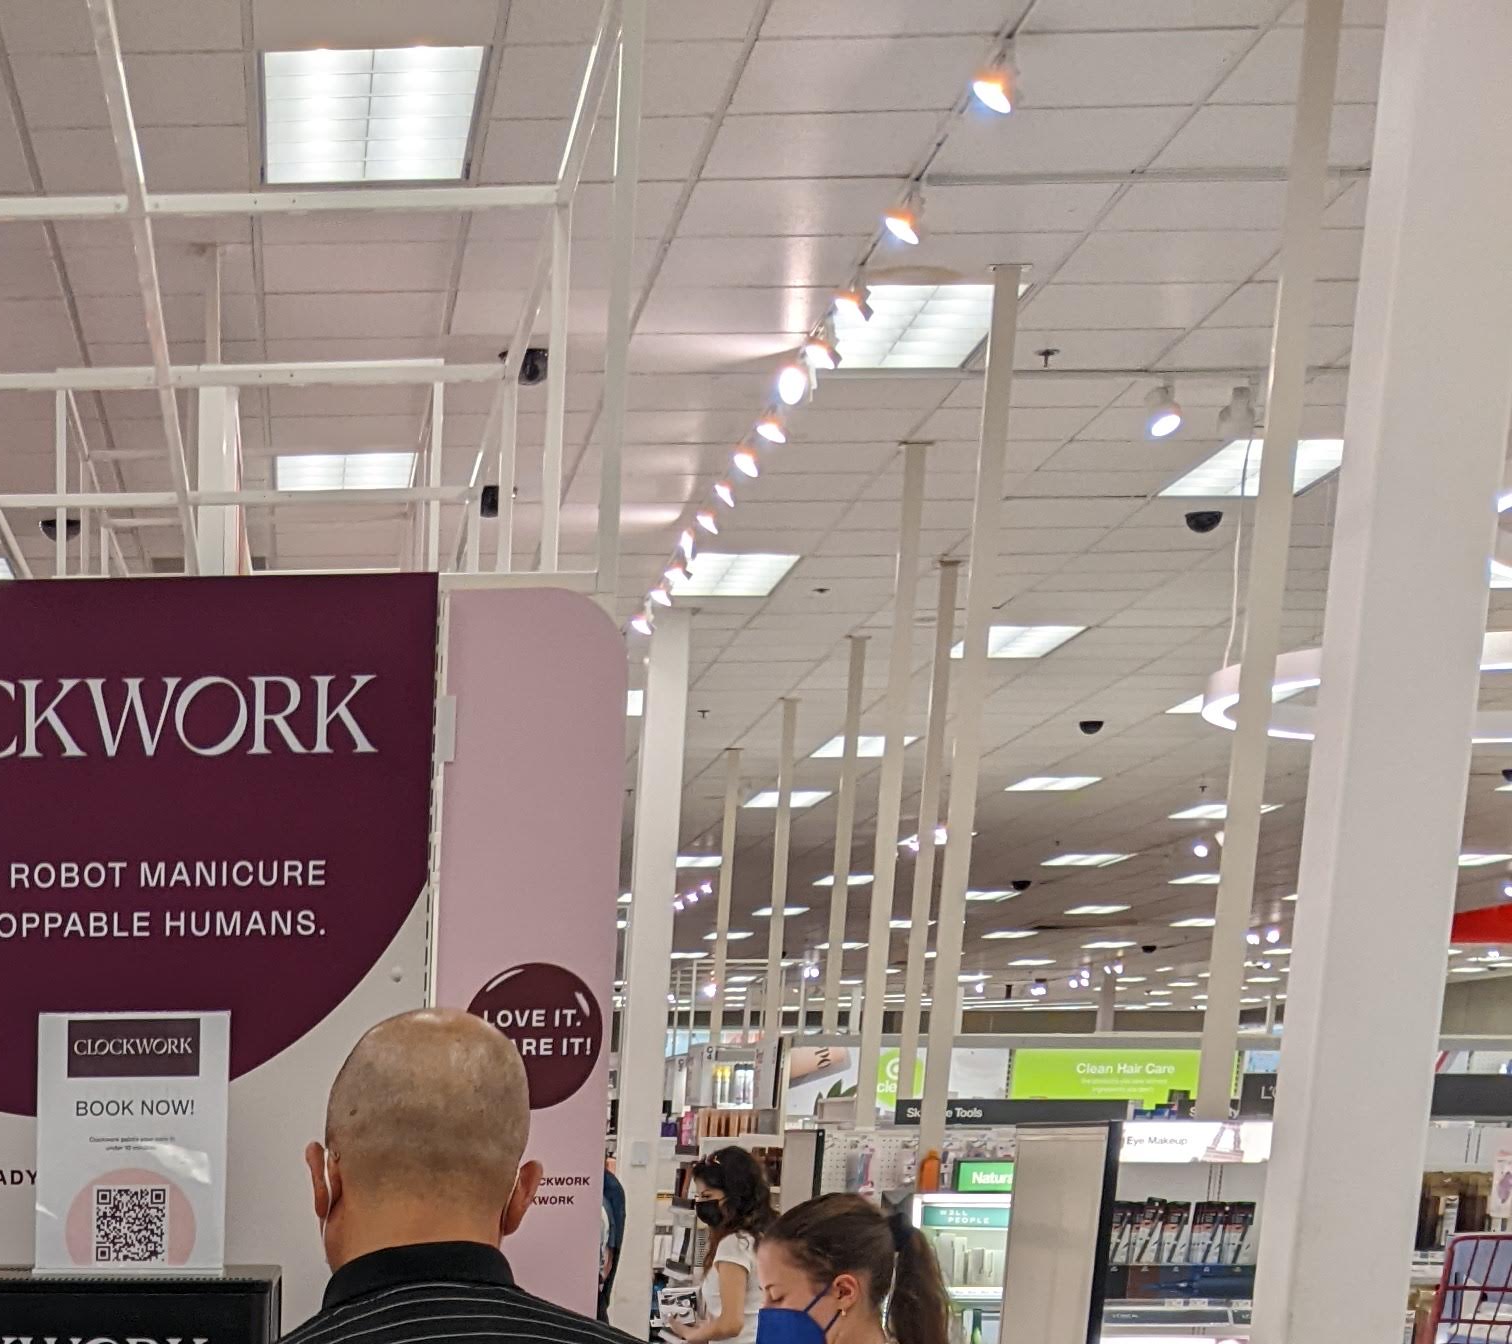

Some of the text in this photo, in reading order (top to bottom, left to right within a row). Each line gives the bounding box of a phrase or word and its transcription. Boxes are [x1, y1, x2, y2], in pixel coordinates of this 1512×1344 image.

[10, 862, 127, 889] ROBOT
[140, 860, 326, 888] MANICURE
[165, 910, 326, 937] HUMANS.
[554, 1009, 581, 1027] IT.
[73, 1037, 193, 1055] CLOCKWORK
[562, 1037, 591, 1055] IT!
[1076, 1063, 1176, 1075] Clean Hair Care
[76, 1100, 194, 1116] BOOK NOW!
[955, 1107, 983, 1118] Tools
[1126, 1136, 1188, 1147] Eye Makeup
[948, 1216, 990, 1224] PEOPLE
